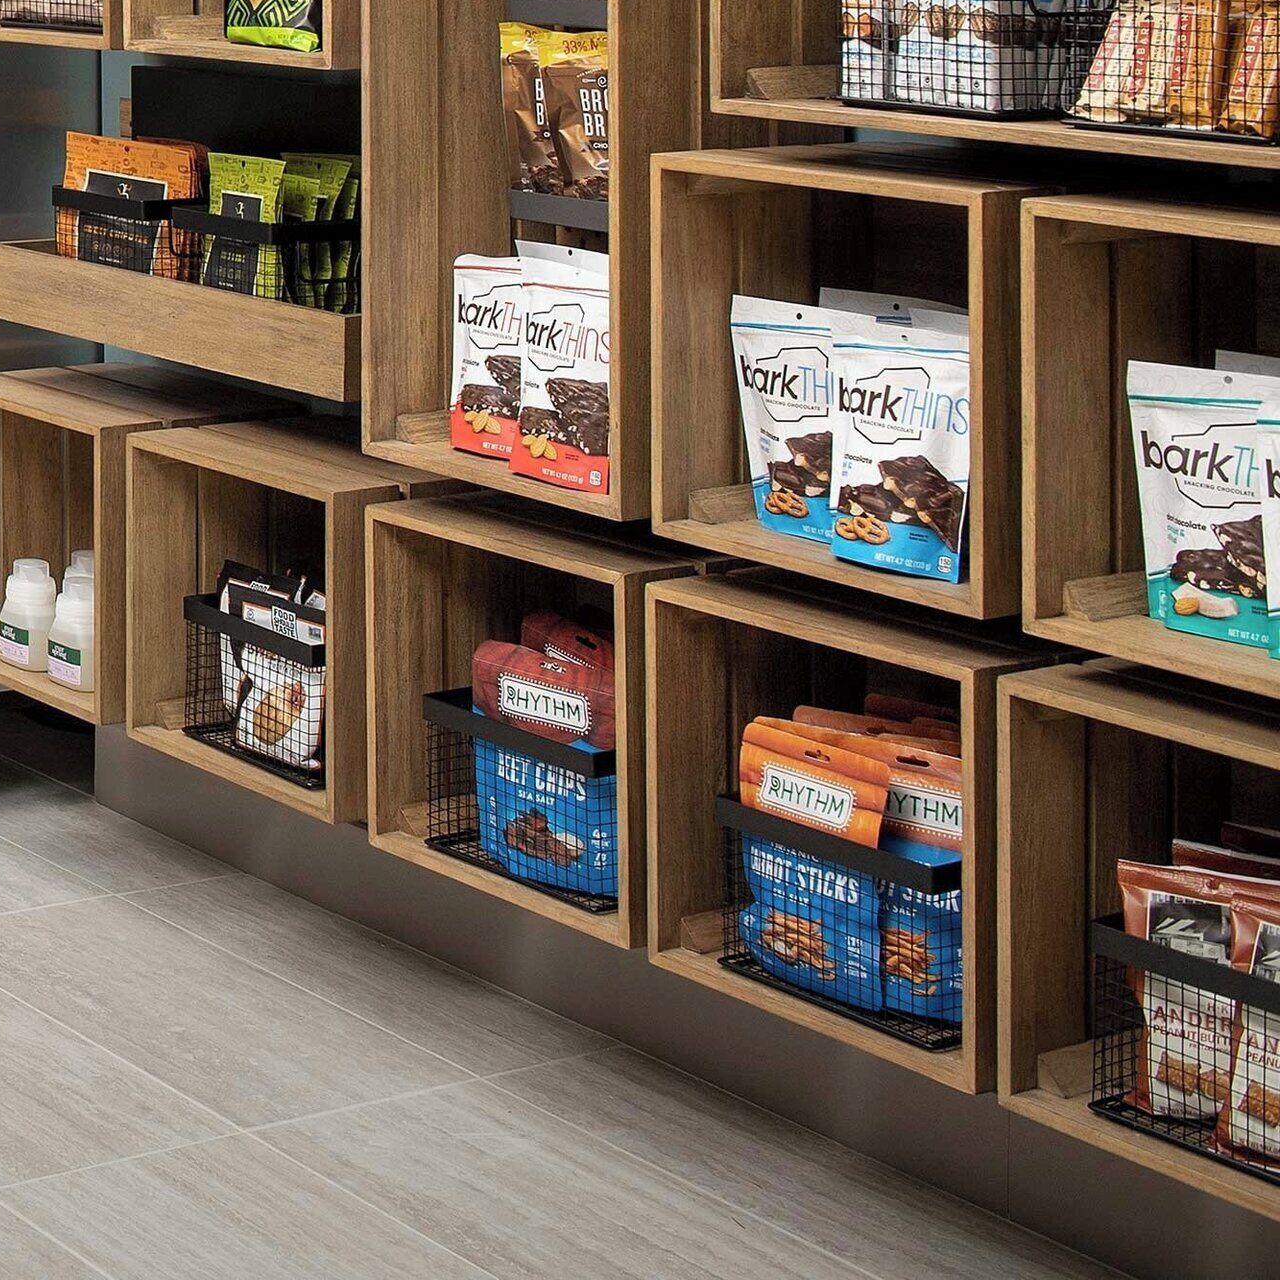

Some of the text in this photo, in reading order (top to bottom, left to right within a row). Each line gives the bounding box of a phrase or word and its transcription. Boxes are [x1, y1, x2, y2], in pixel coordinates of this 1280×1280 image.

[562, 39, 588, 55] 33%
[1183, 479, 1255, 498] SNACKING CHOCOLATE
[273, 608, 294, 621] FOOD
[273, 624, 296, 638] TASTE
[505, 685, 584, 722] RHYTHM
[534, 762, 587, 801] CHIPS
[518, 789, 556, 806] SEA SALT
[769, 773, 846, 819] RHYTHM
[796, 859, 860, 906] STICKS
[1153, 1022, 1197, 1042] PEANUT
